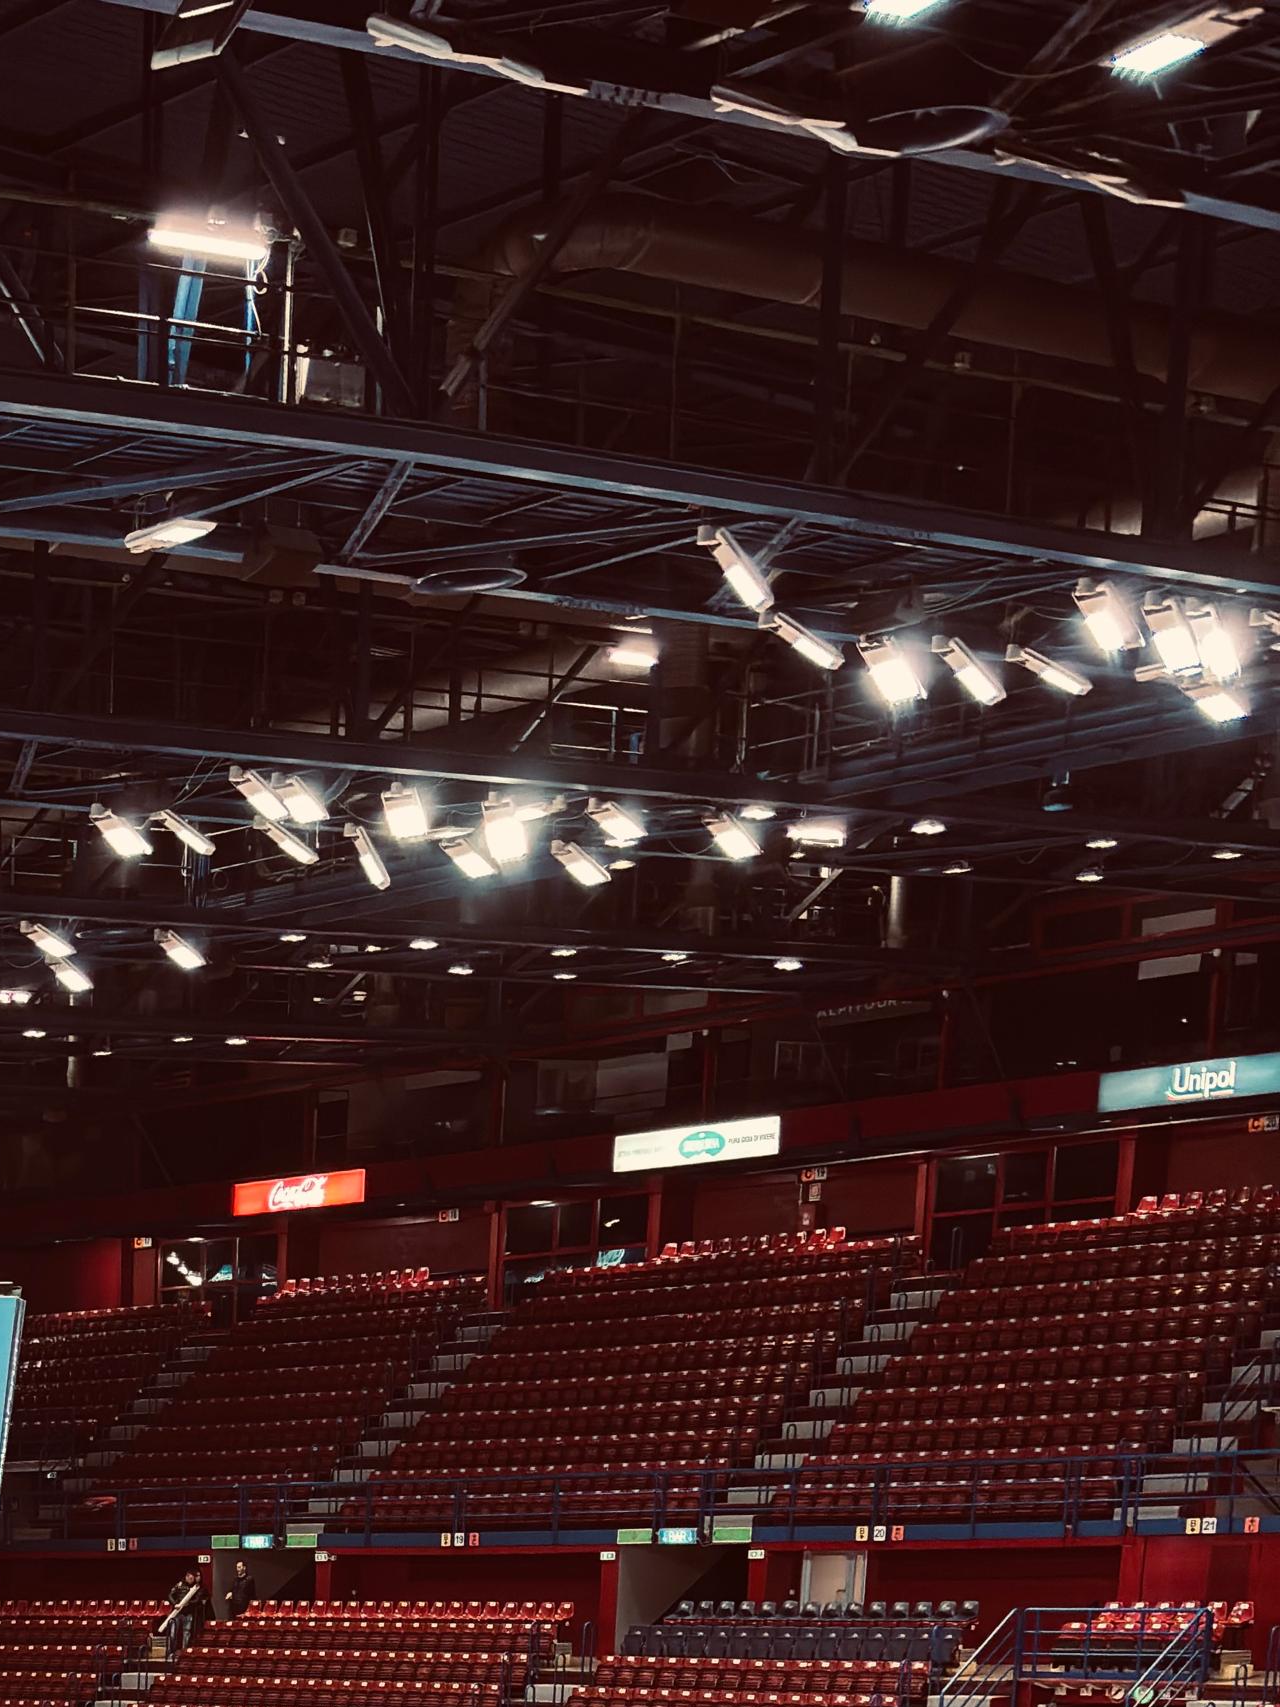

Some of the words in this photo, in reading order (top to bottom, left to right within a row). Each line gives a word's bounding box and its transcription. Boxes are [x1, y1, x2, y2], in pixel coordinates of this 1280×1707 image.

[1172, 1061, 1237, 1097] Unipol
[1203, 1521, 1214, 1531] 21
[875, 1528, 885, 1538] 20
[455, 1534, 463, 1543] 19
